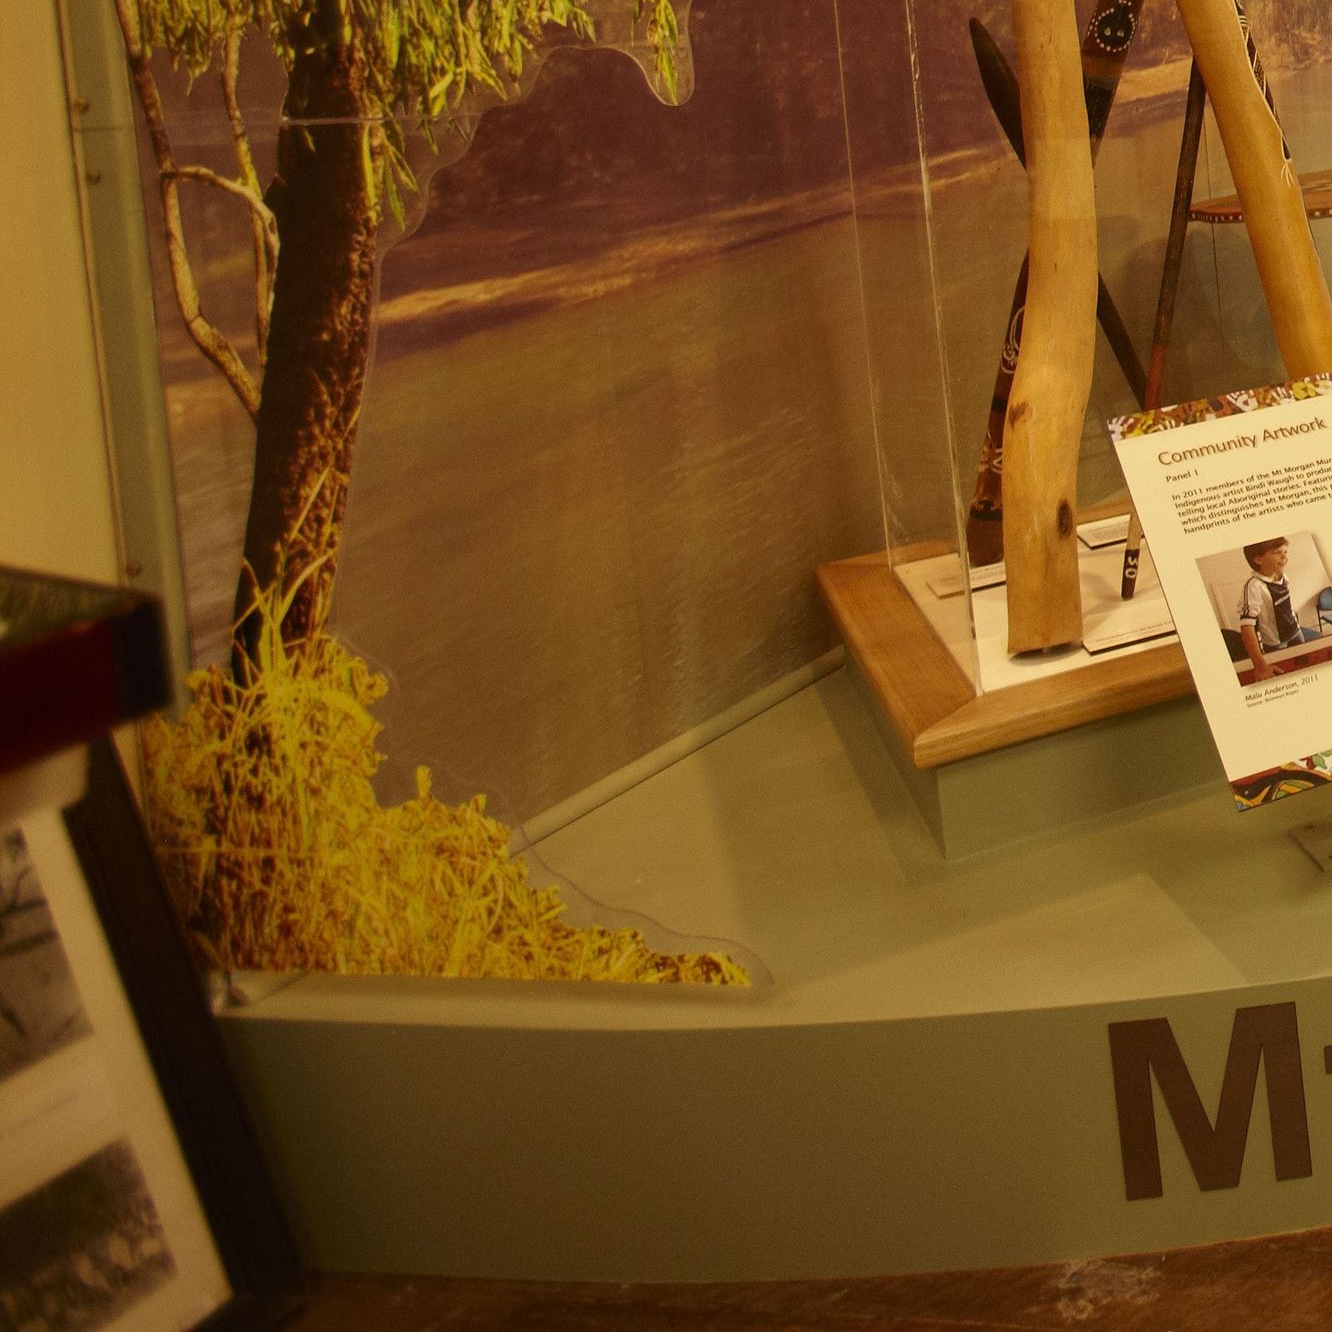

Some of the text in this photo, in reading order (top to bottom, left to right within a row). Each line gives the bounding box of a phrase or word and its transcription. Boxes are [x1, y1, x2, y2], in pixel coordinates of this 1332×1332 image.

[1157, 417, 1327, 465] Community Artwork
[1166, 470, 1191, 483] Panel
[1177, 506, 1205, 517] telling
[1205, 499, 1226, 510] local
[1228, 488, 1270, 504] Aboriginal
[1272, 483, 1301, 494] stories.
